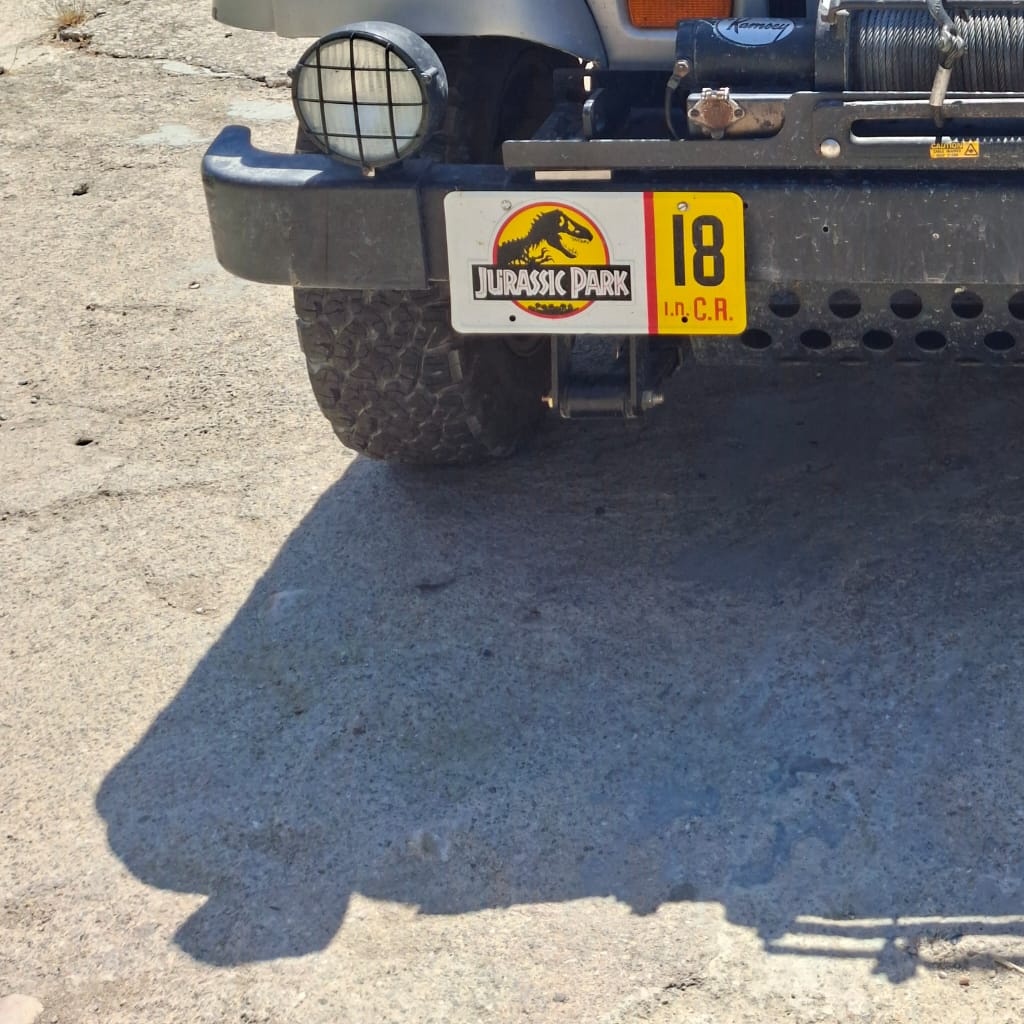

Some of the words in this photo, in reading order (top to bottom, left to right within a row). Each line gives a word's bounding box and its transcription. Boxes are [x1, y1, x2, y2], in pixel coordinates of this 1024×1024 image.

[672, 214, 725, 286] 18
[475, 266, 567, 299] JURASSIC
[570, 266, 630, 299] PARK
